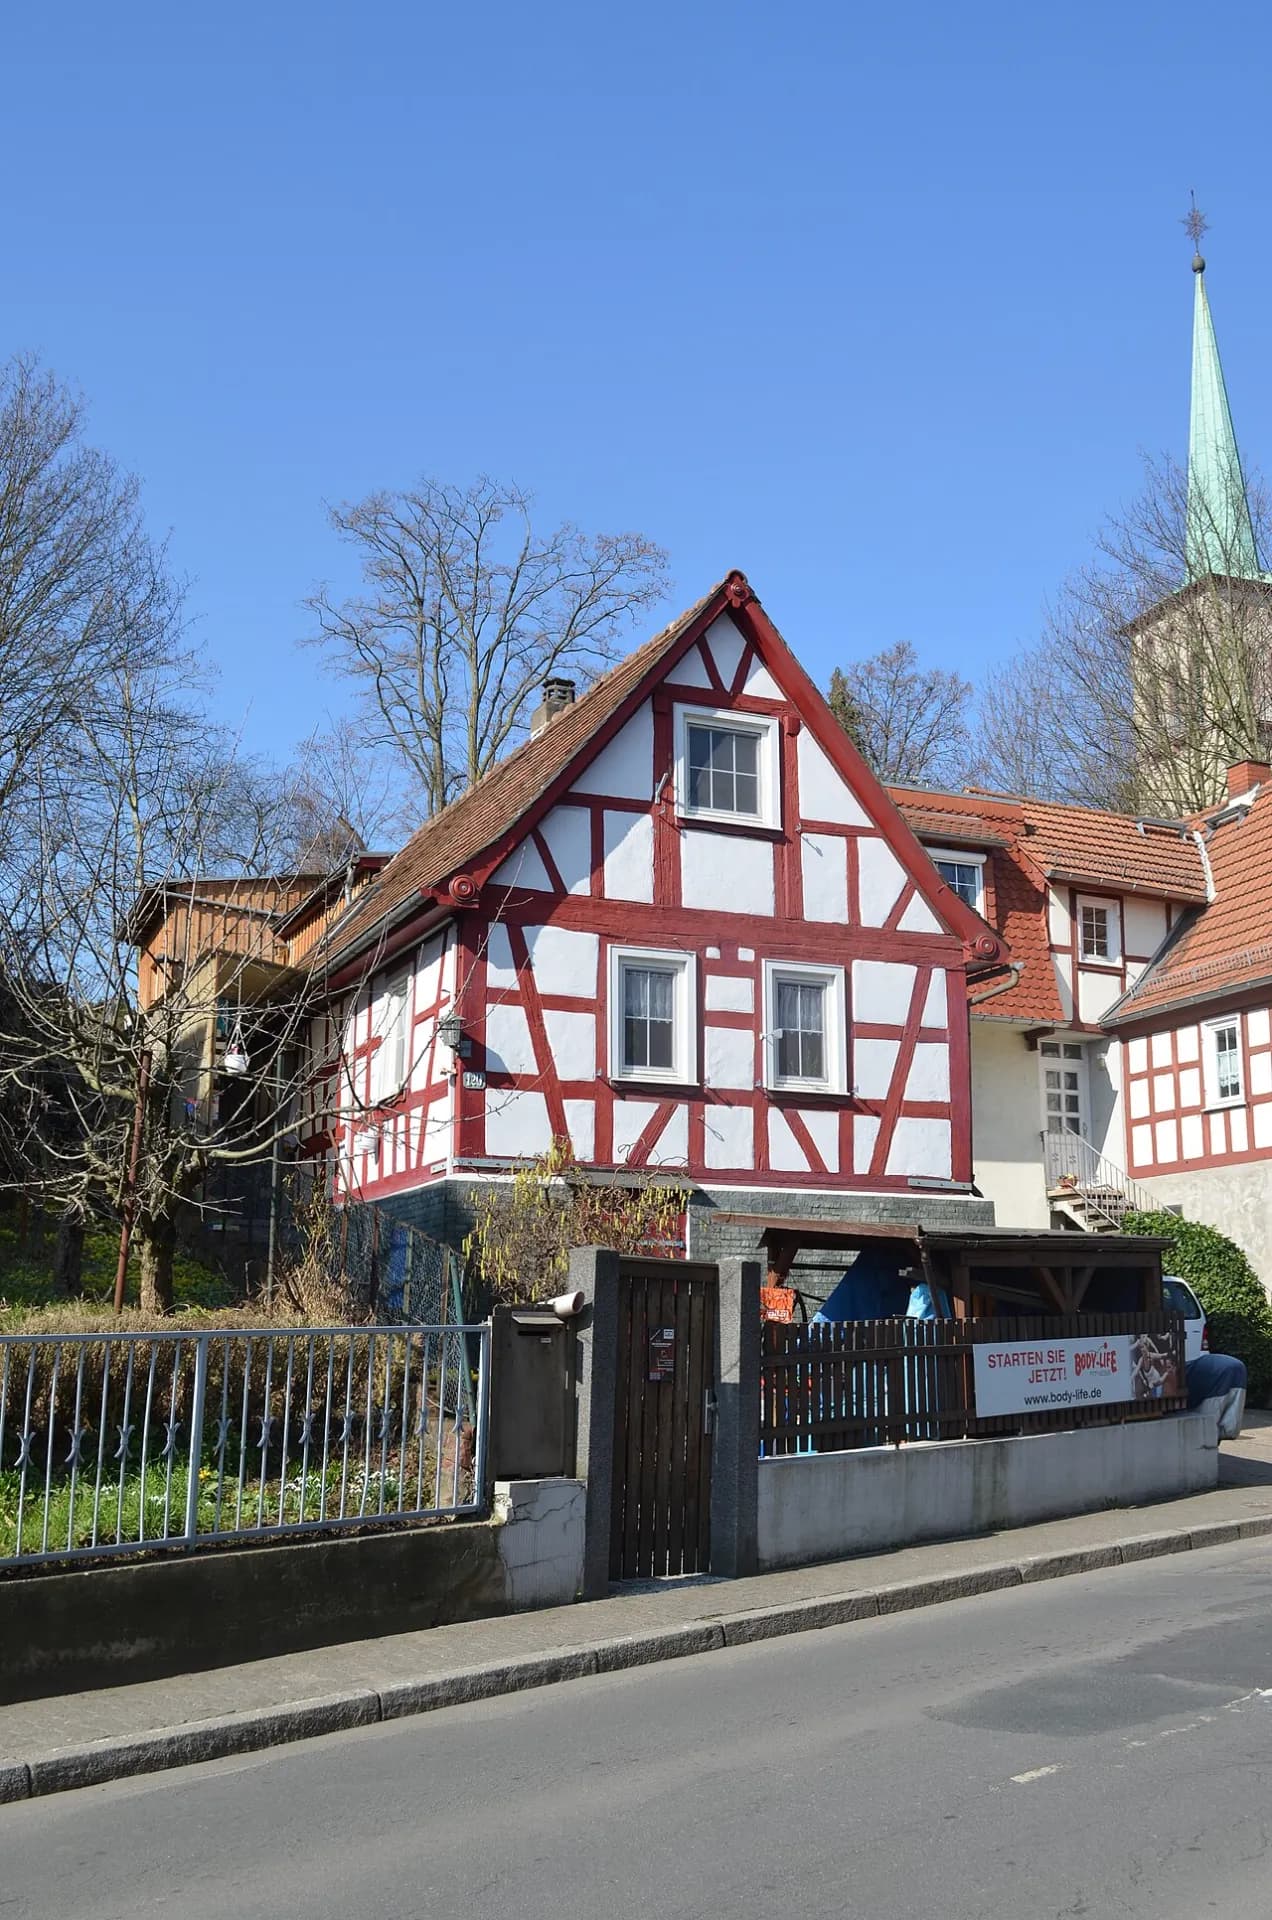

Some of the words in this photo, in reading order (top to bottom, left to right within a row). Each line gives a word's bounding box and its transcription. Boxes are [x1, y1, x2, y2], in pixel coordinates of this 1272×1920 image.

[988, 1351, 1043, 1368] STARTEN
[1047, 1349, 1066, 1364] SIE
[1028, 1367, 1067, 1383] JETZT!
[1023, 1387, 1102, 1406] www.body-life.de
